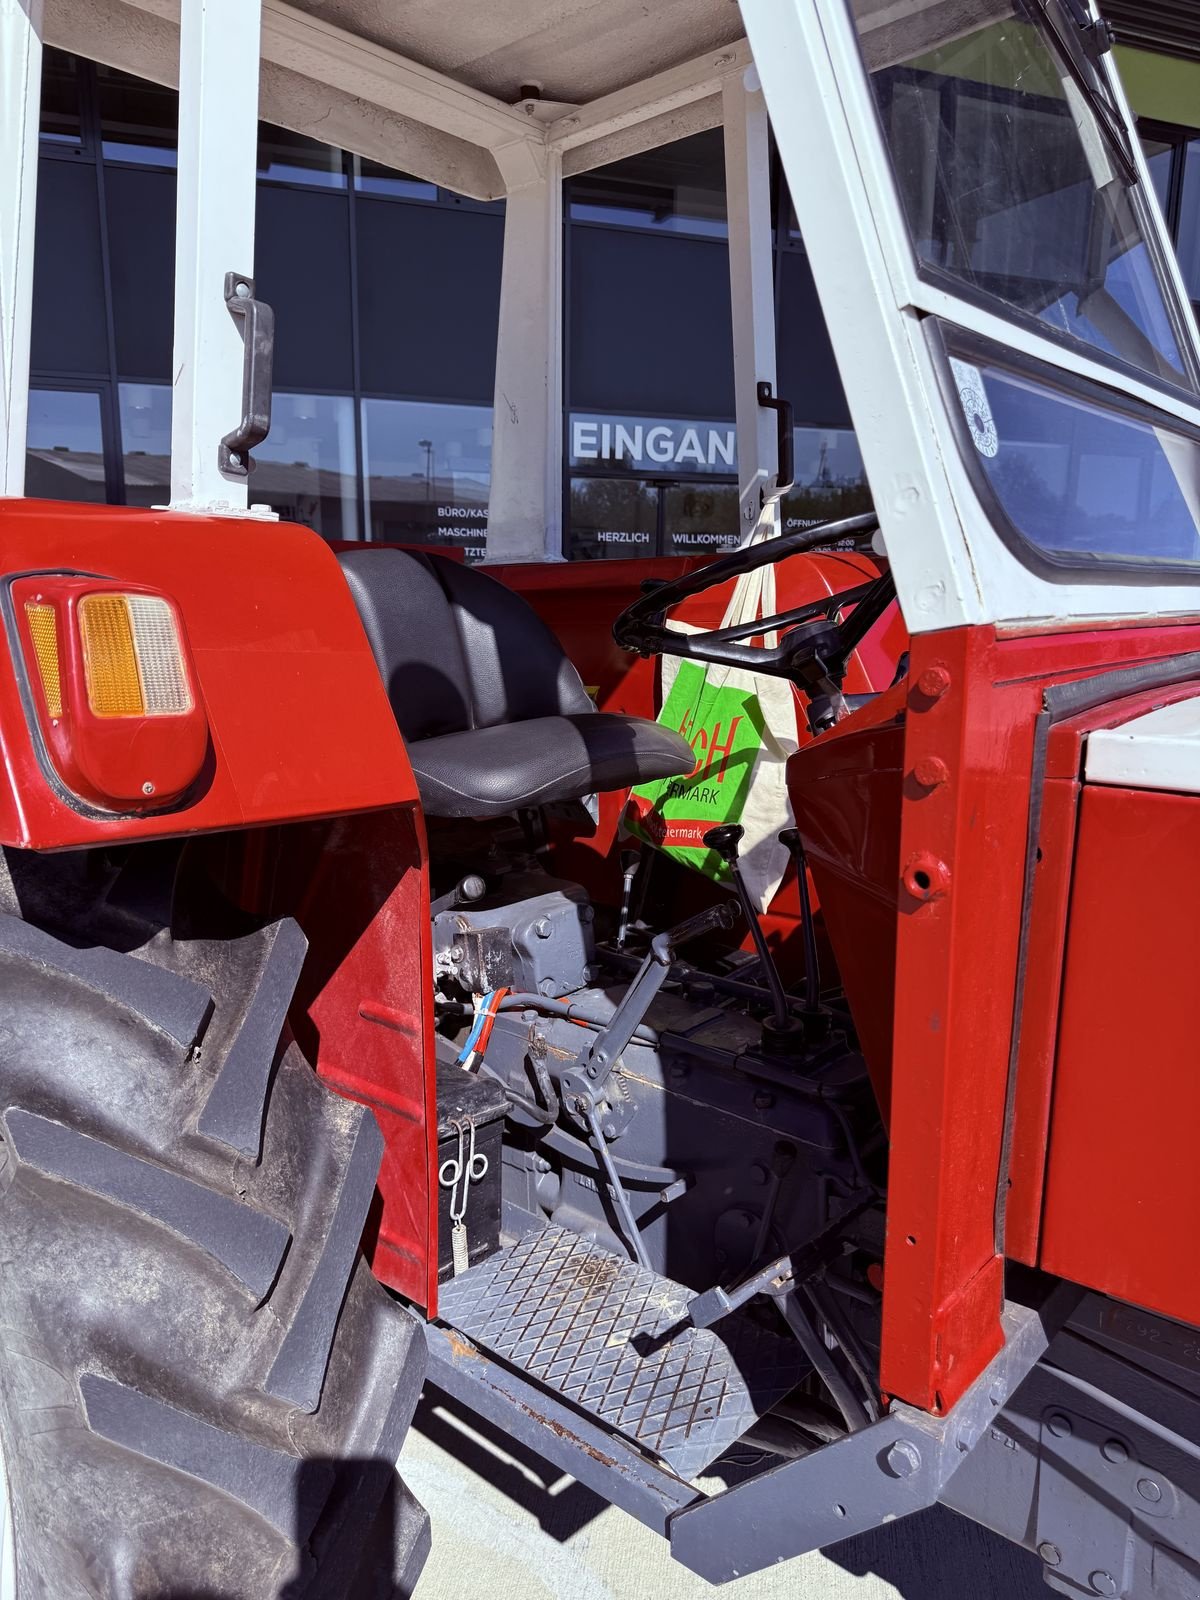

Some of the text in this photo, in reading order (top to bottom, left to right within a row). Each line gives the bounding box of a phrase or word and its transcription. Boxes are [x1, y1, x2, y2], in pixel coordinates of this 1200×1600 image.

[573, 422, 735, 465] EINGAN
[438, 506, 489, 518] BÜRO/KAS
[438, 527, 488, 537] MASCHINE
[597, 531, 741, 545] HERZLICH WILLKOMMEN
[464, 547, 487, 557] TZTE
